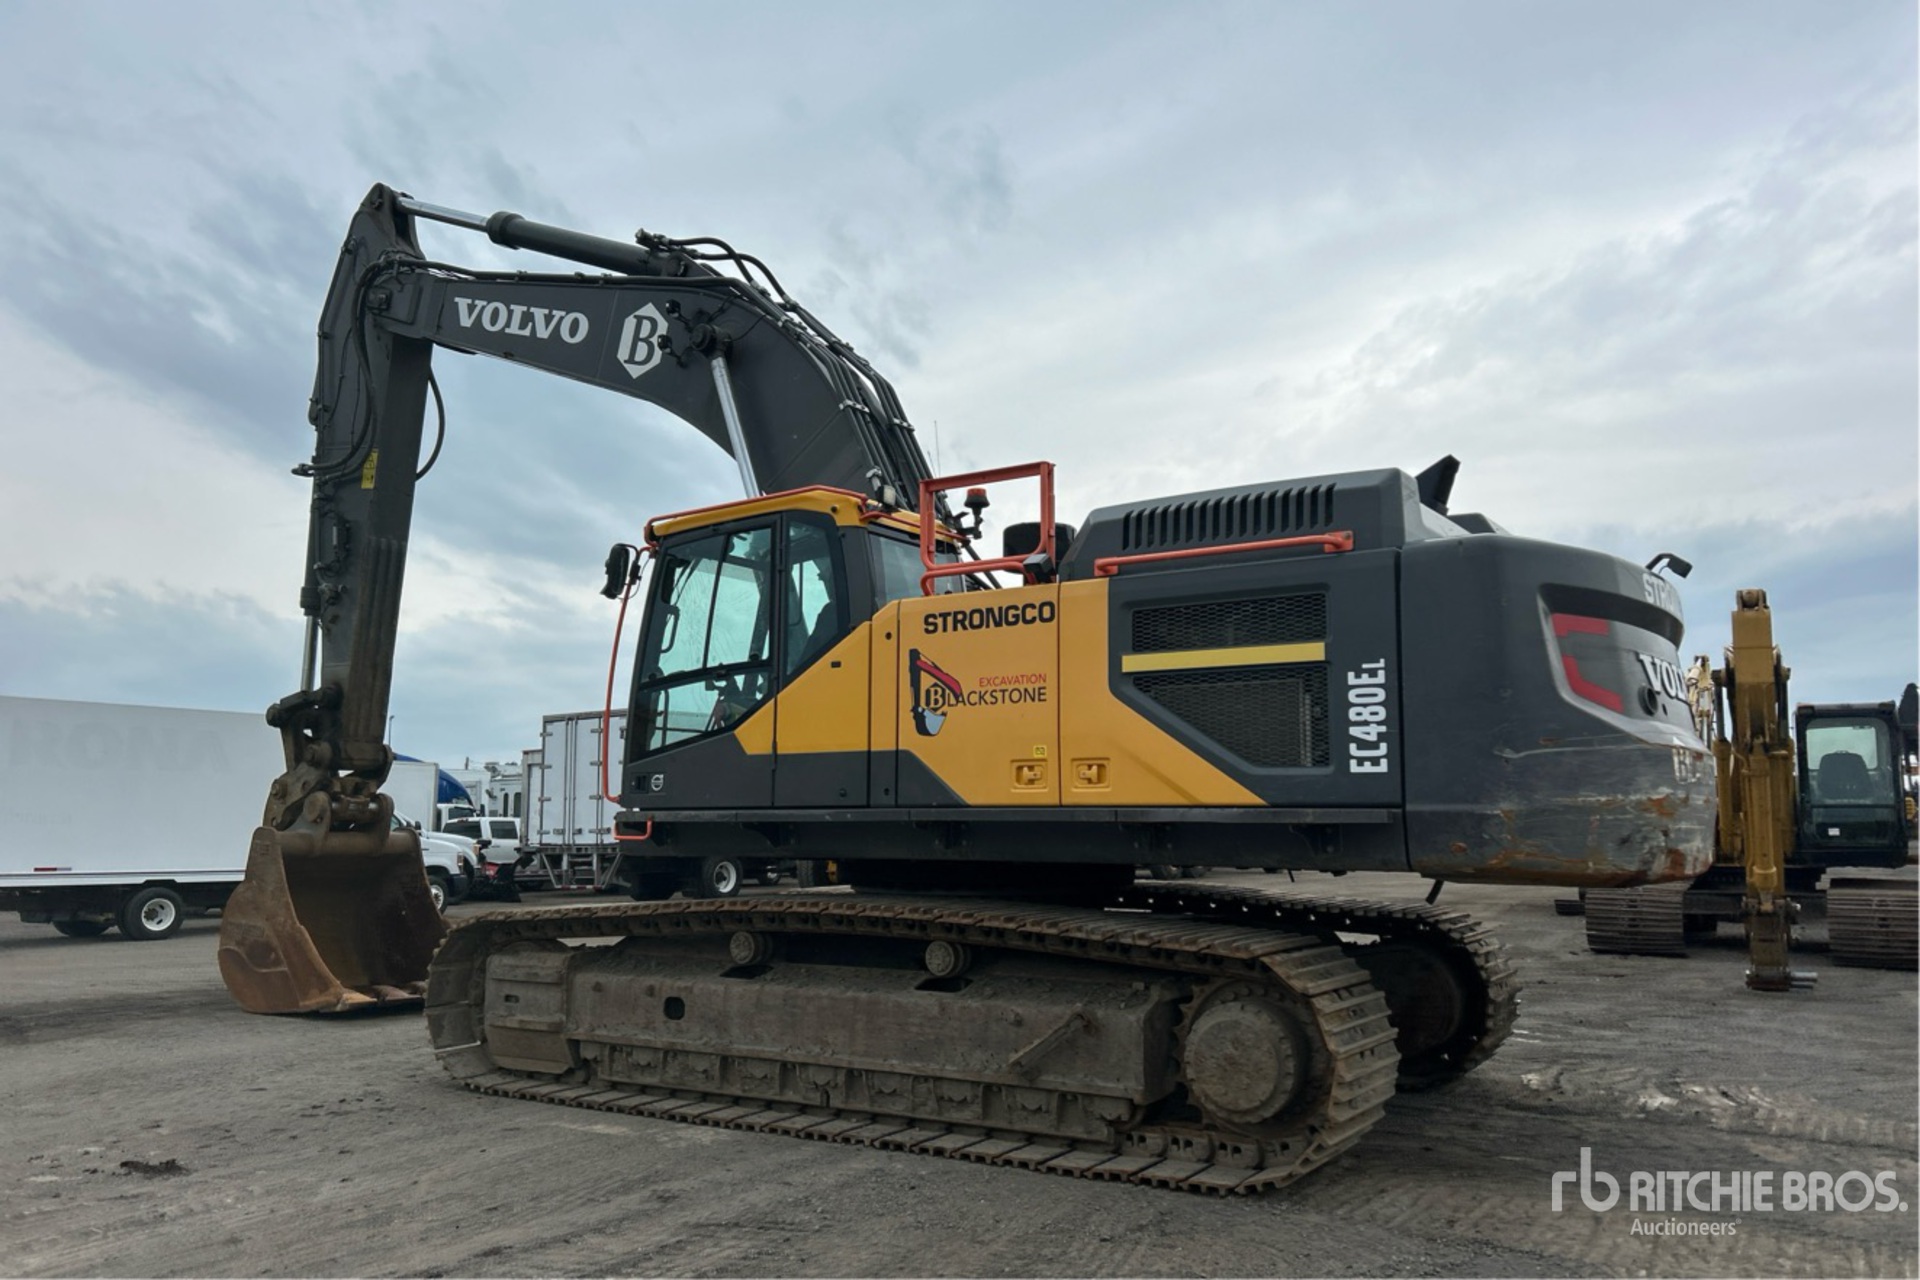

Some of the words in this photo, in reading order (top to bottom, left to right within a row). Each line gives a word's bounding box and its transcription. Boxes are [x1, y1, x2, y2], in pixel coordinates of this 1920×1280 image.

[454, 297, 589, 344] VOLVO
[924, 601, 1055, 634] STRONGCO
[979, 673, 1047, 687] EXCAVATION
[1347, 658, 1388, 773] EC480EL
